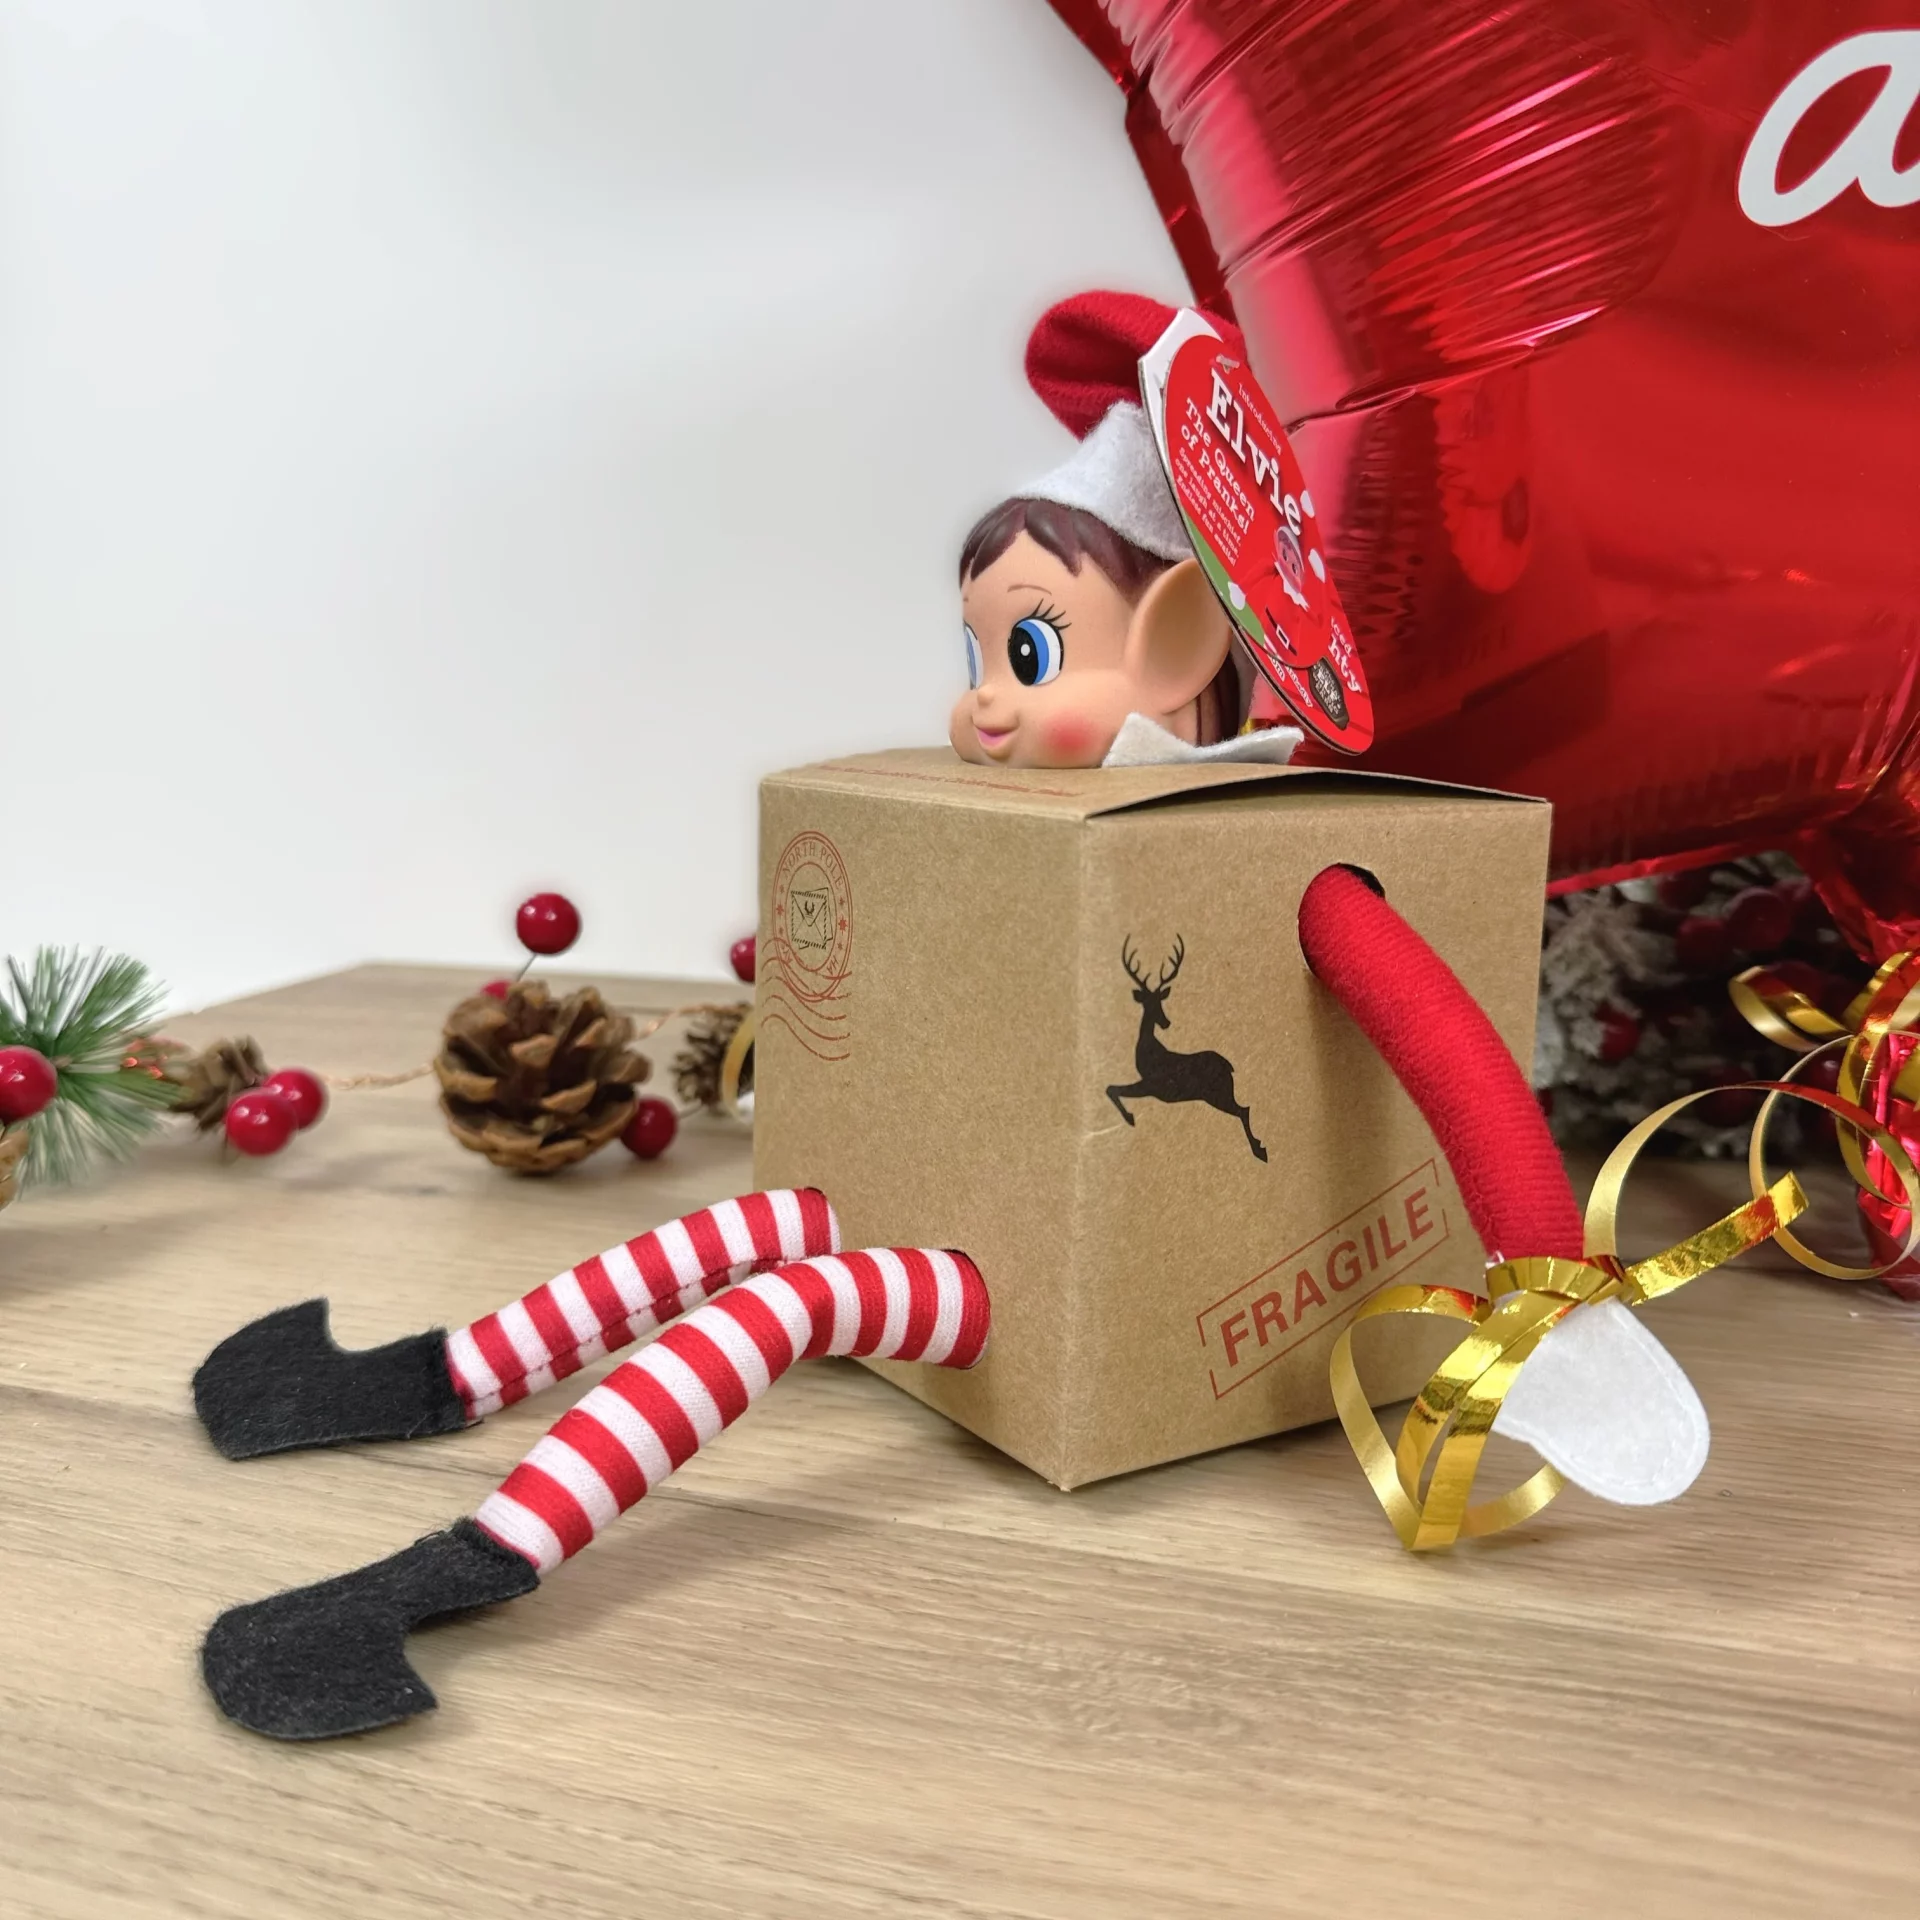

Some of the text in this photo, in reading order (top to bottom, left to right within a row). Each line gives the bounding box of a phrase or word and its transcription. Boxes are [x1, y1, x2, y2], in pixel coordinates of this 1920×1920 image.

[1206, 367, 1302, 537] Elvie
[1238, 382, 1282, 456] Introducing
[1175, 458, 1188, 478] one
[1189, 477, 1208, 510] laugh
[1179, 446, 1212, 501] Spreading
[1181, 424, 1250, 536] of Pranks!
[1185, 397, 1255, 523] The Queen
[1177, 474, 1201, 516] Endless
[1201, 513, 1214, 534] fun
[782, 841, 844, 890] NORTH POLE
[1219, 1186, 1434, 1368] FRAGILE
